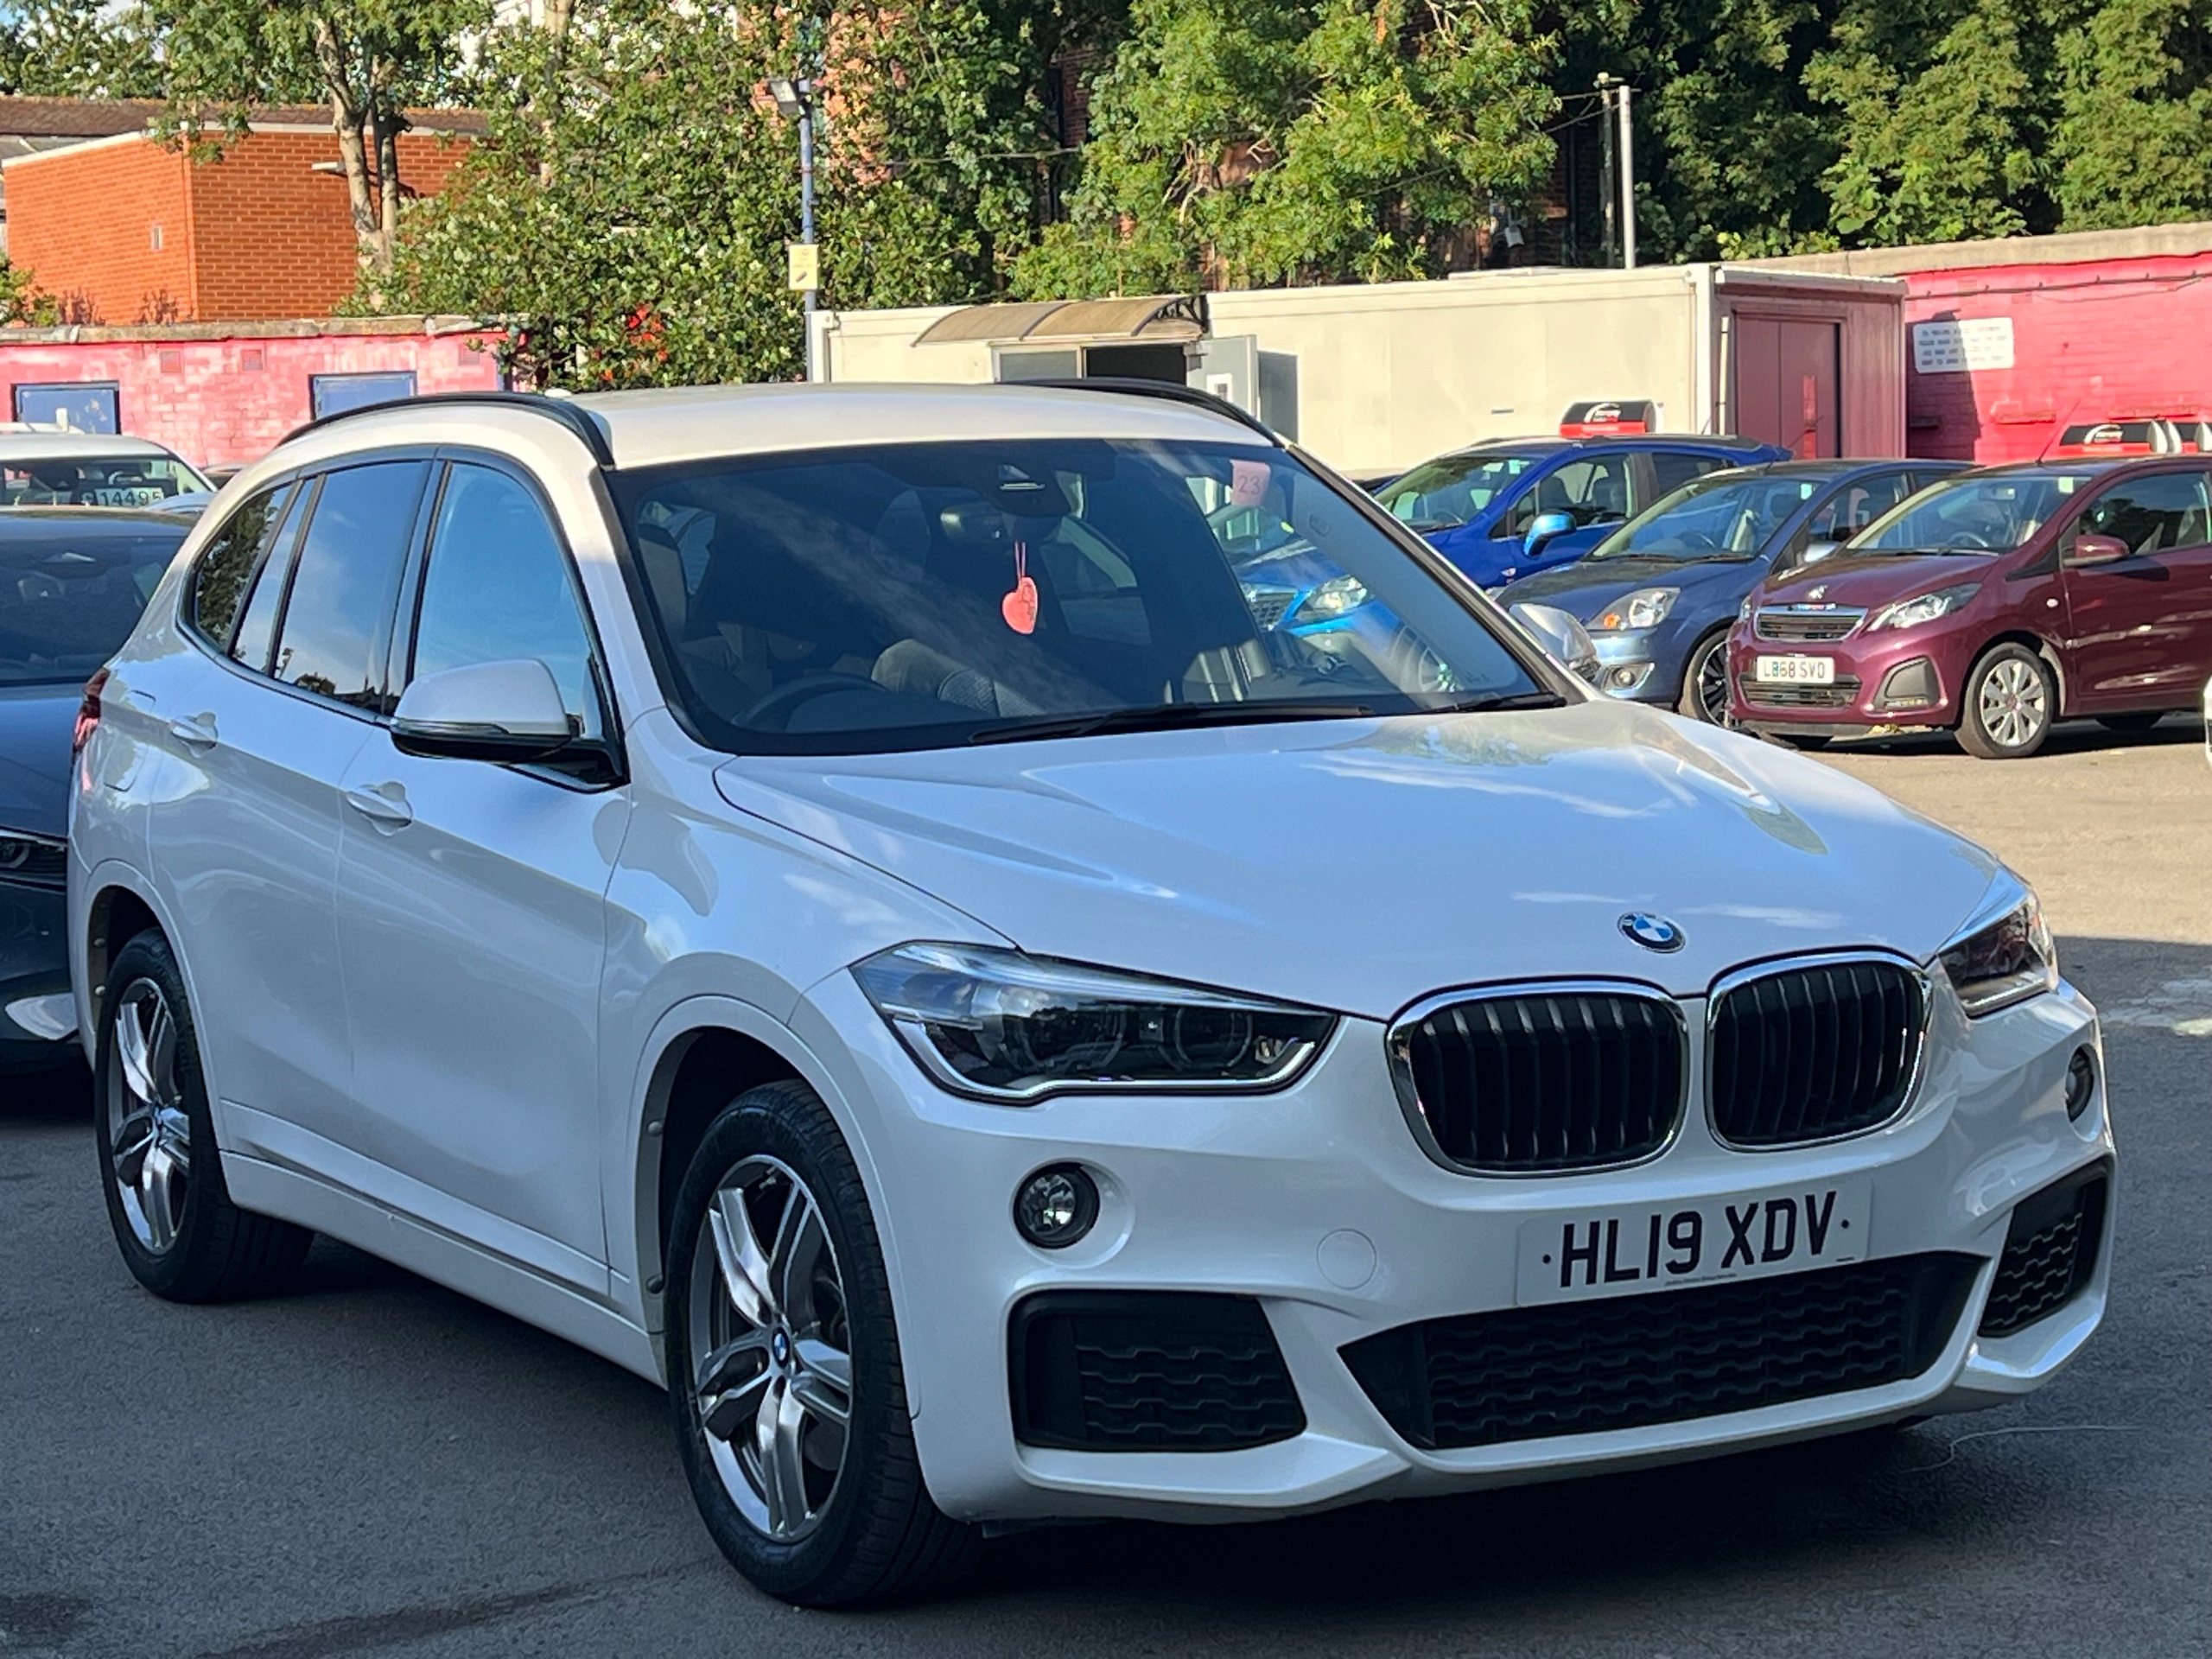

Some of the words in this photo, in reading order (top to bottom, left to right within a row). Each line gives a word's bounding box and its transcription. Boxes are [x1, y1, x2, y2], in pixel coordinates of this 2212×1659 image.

[1237, 474, 1262, 496] 23
[1560, 1211, 1703, 1288] HL19
[1720, 1190, 1837, 1269] XDV
